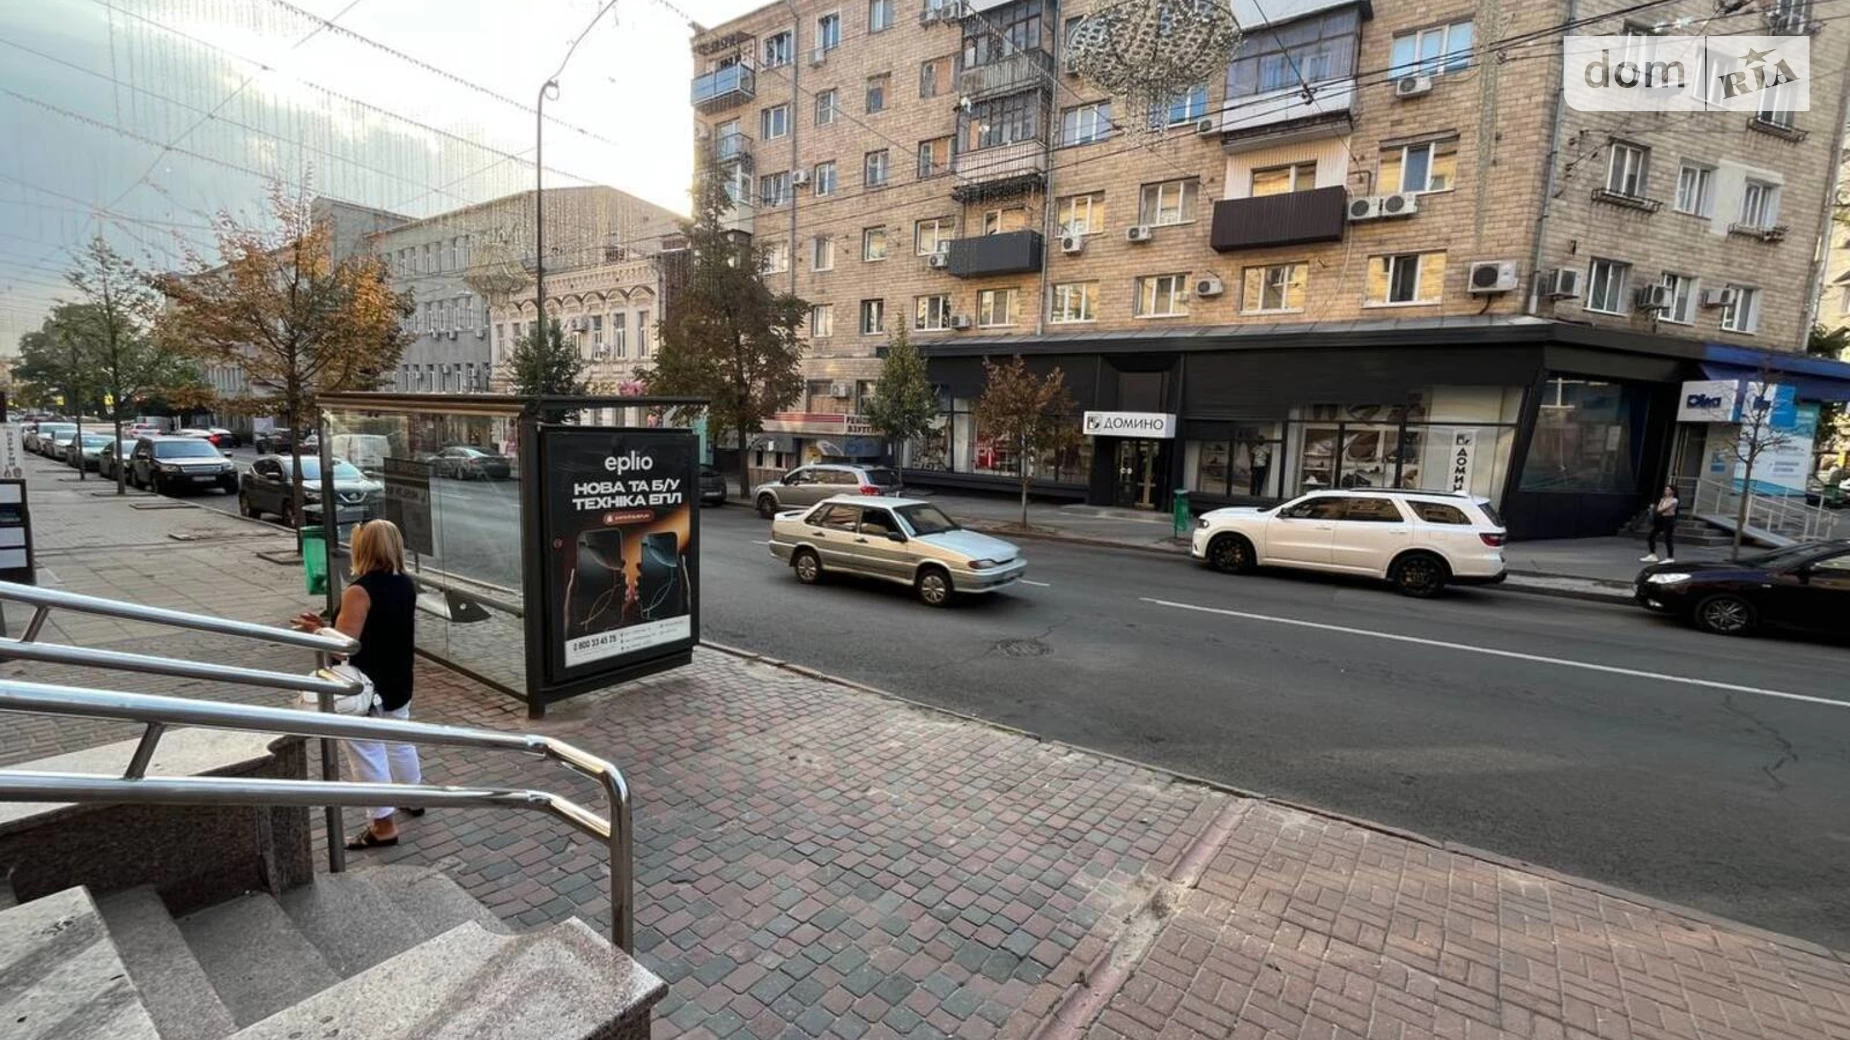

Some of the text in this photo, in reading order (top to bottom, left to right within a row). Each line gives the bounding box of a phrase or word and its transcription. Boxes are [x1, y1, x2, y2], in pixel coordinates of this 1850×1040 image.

[1103, 417, 1165, 430] ДОМИНО
[604, 450, 654, 476] eplio
[573, 477, 681, 496] НОВА ТА Б/У
[572, 492, 683, 511] ТЕХНІКА ЕПЛ
